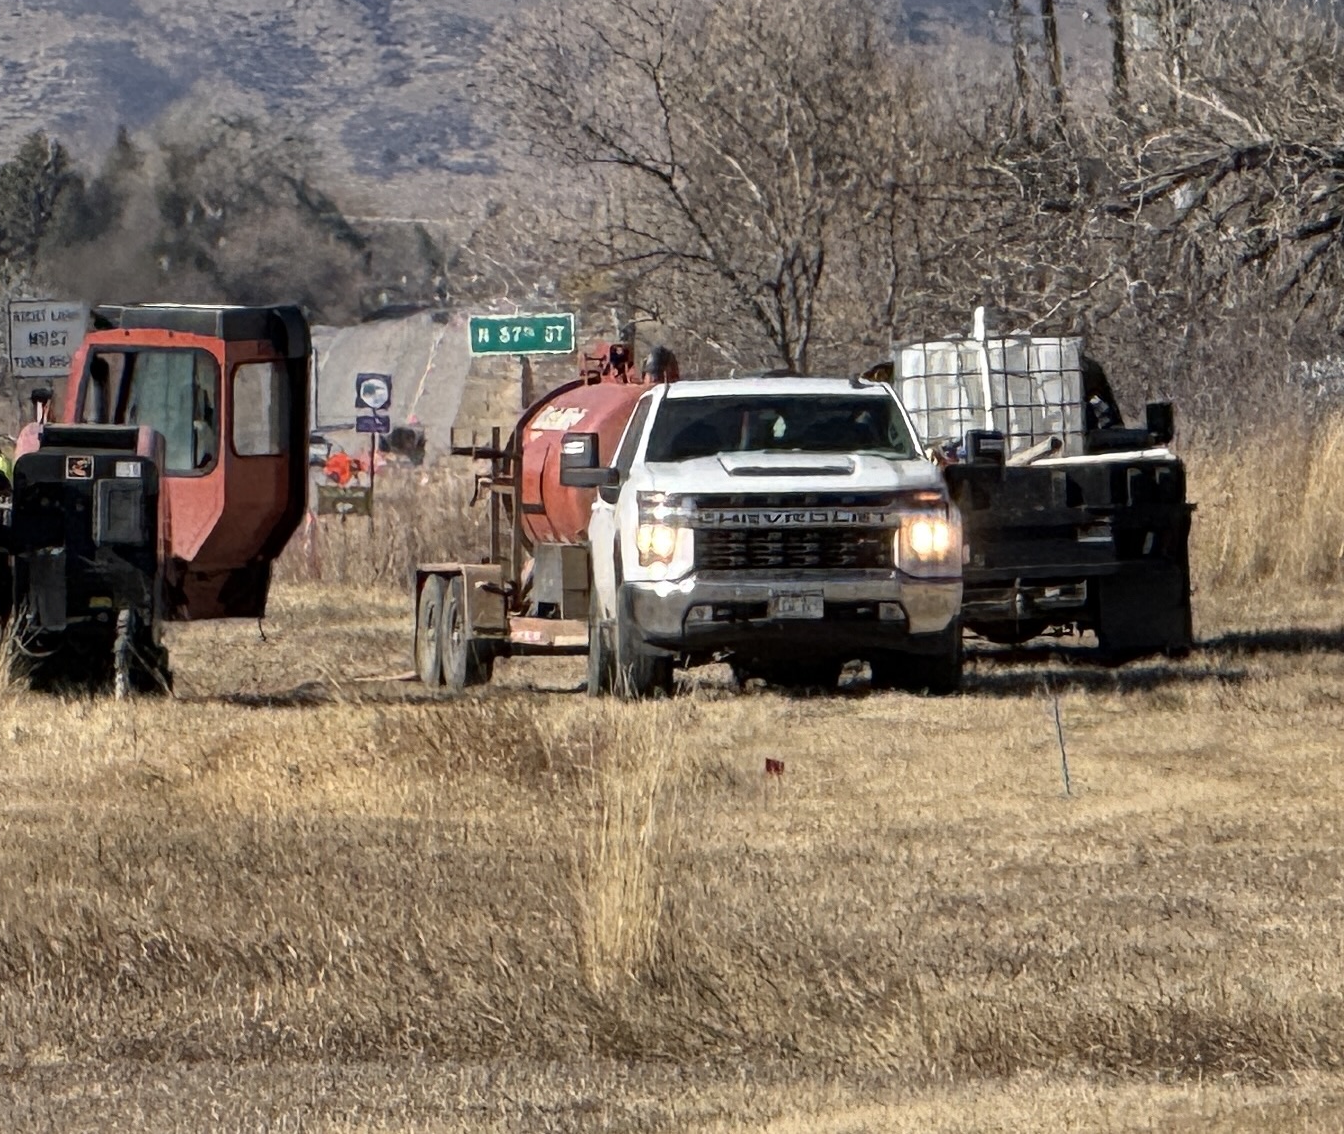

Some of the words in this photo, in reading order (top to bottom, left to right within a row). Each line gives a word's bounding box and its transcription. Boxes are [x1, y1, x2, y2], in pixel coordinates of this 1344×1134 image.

[478, 327, 490, 343] N
[544, 325, 565, 343] ST
[697, 510, 891, 524] CHEVROLET
